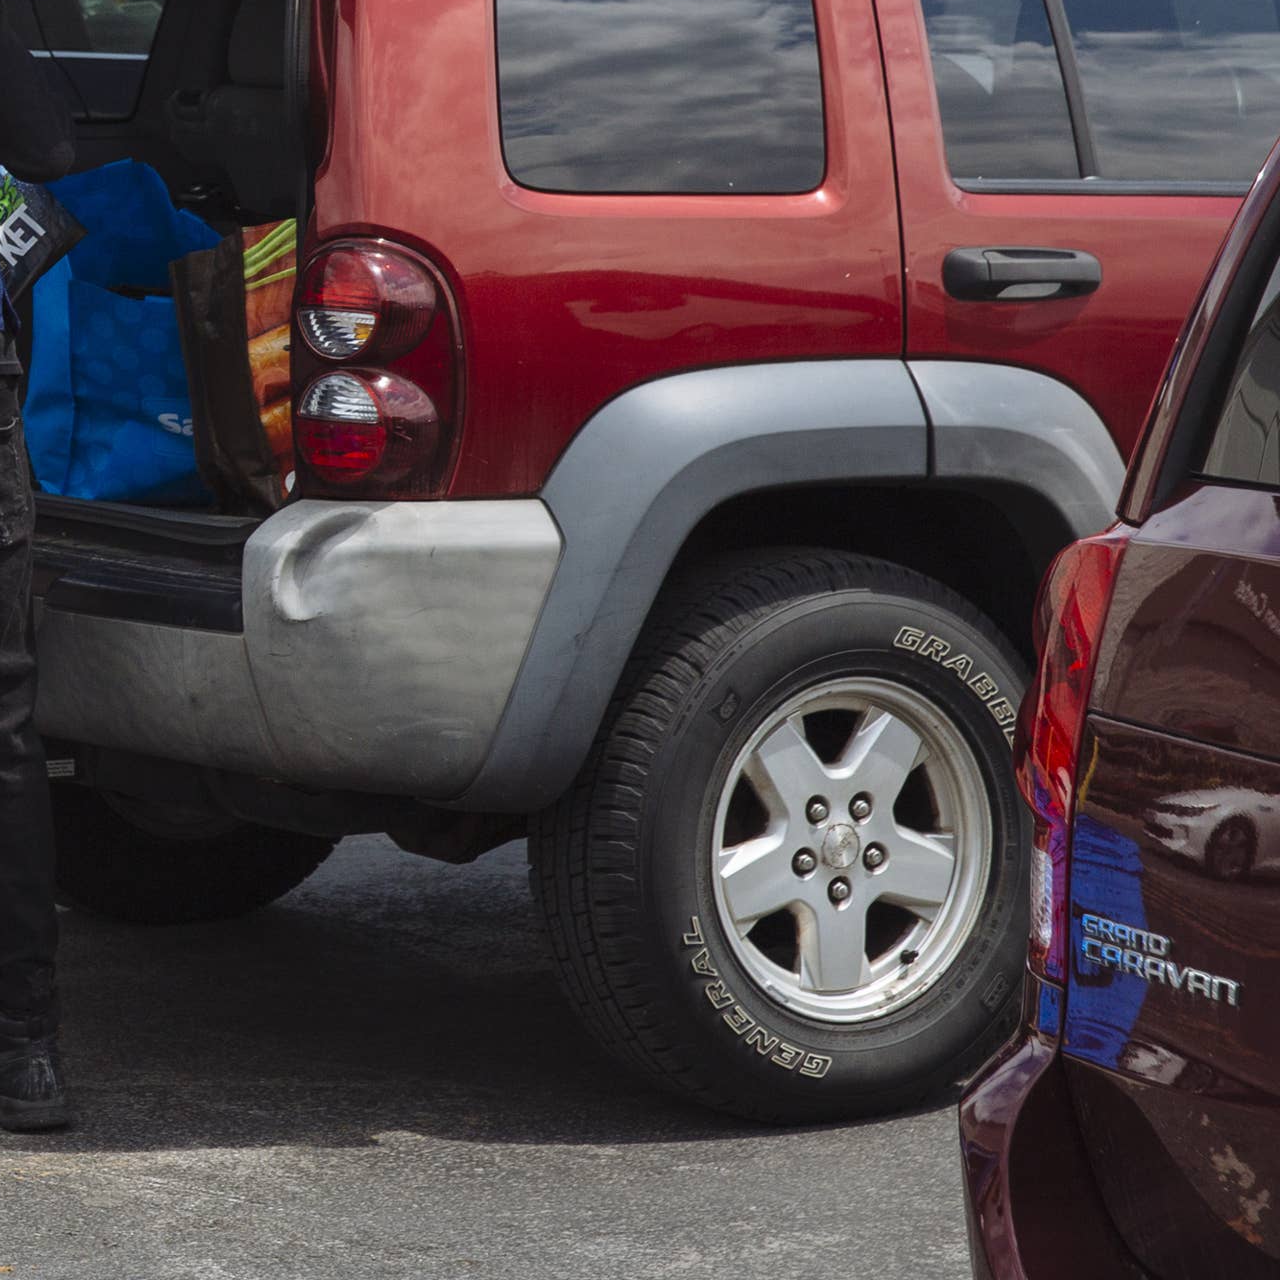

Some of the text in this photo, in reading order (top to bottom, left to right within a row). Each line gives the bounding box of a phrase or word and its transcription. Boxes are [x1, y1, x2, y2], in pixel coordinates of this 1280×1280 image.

[1081, 913, 1172, 957] GRAND
[683, 915, 833, 1078] GENERAL
[1081, 936, 1240, 1007] CARAVAN
